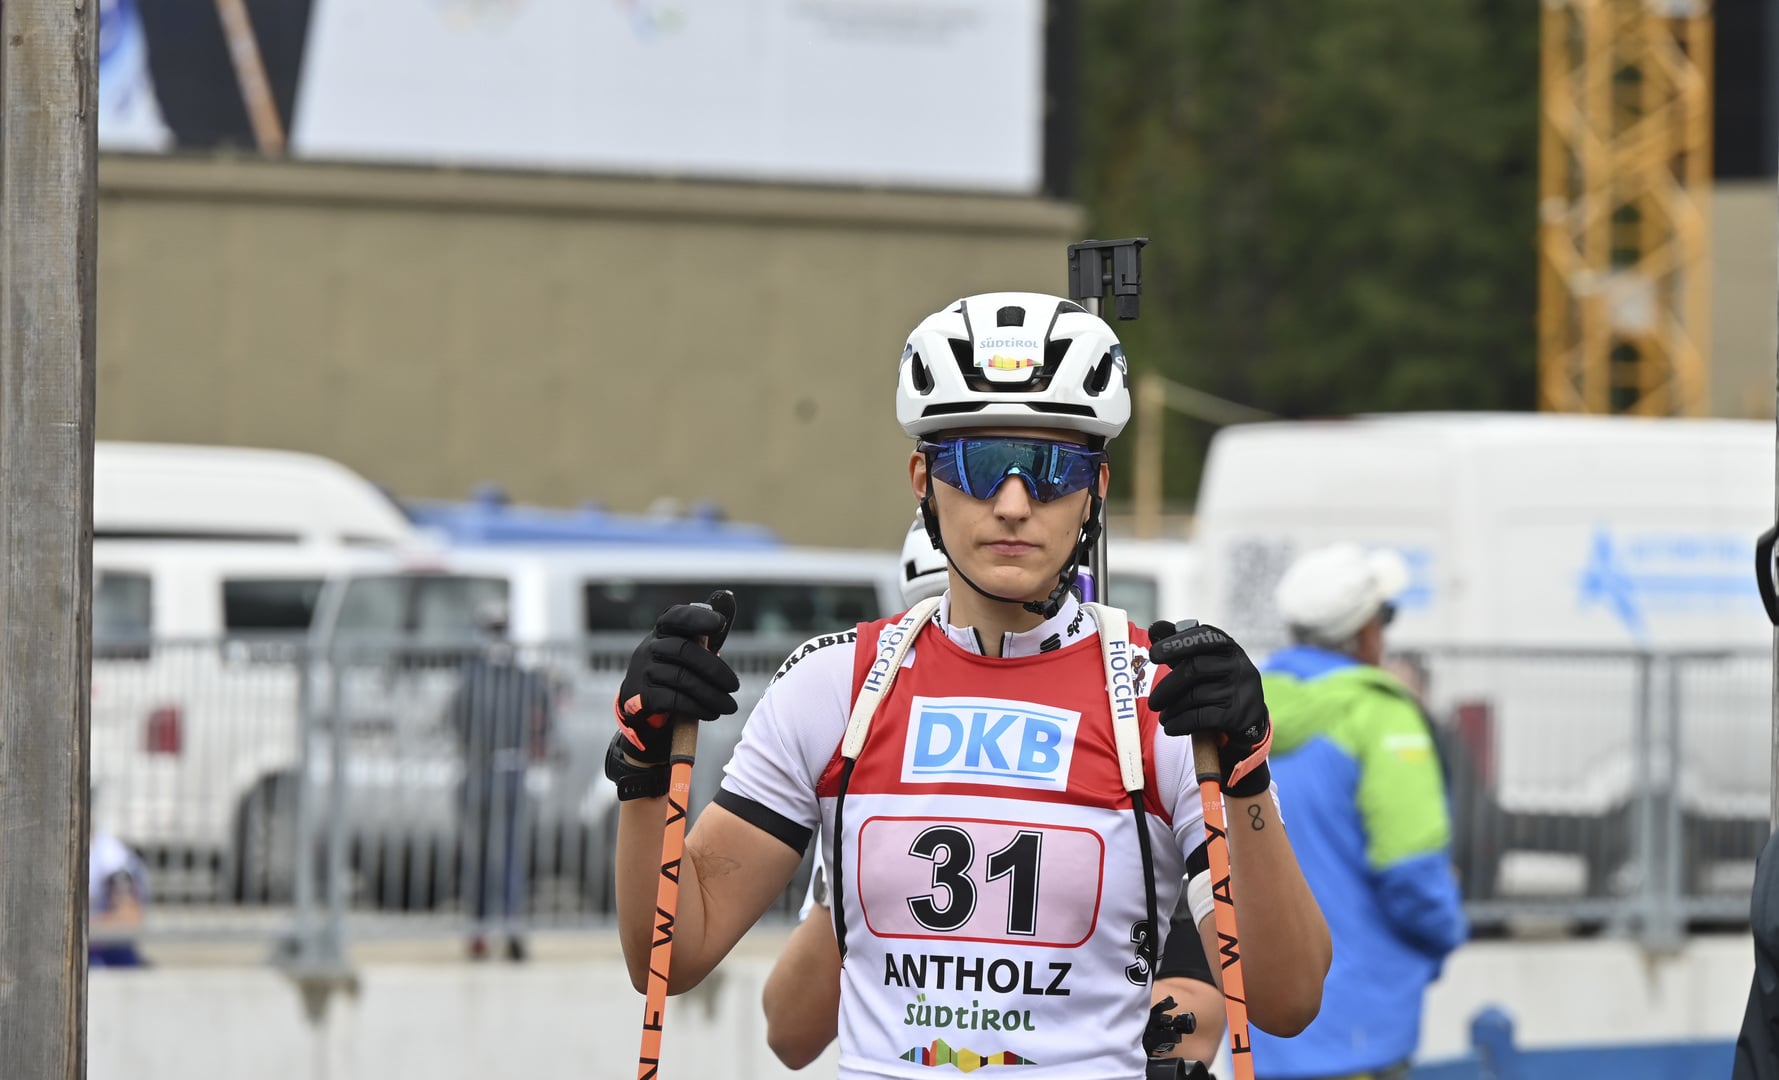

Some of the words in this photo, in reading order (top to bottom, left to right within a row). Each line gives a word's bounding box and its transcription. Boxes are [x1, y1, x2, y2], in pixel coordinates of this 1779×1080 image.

[864, 617, 915, 692] FIOCCHI
[1109, 640, 1135, 720] FIOCCHI
[913, 711, 1062, 773] DKB
[906, 825, 1043, 936] 31
[884, 952, 1072, 996] ANTHOLZ
